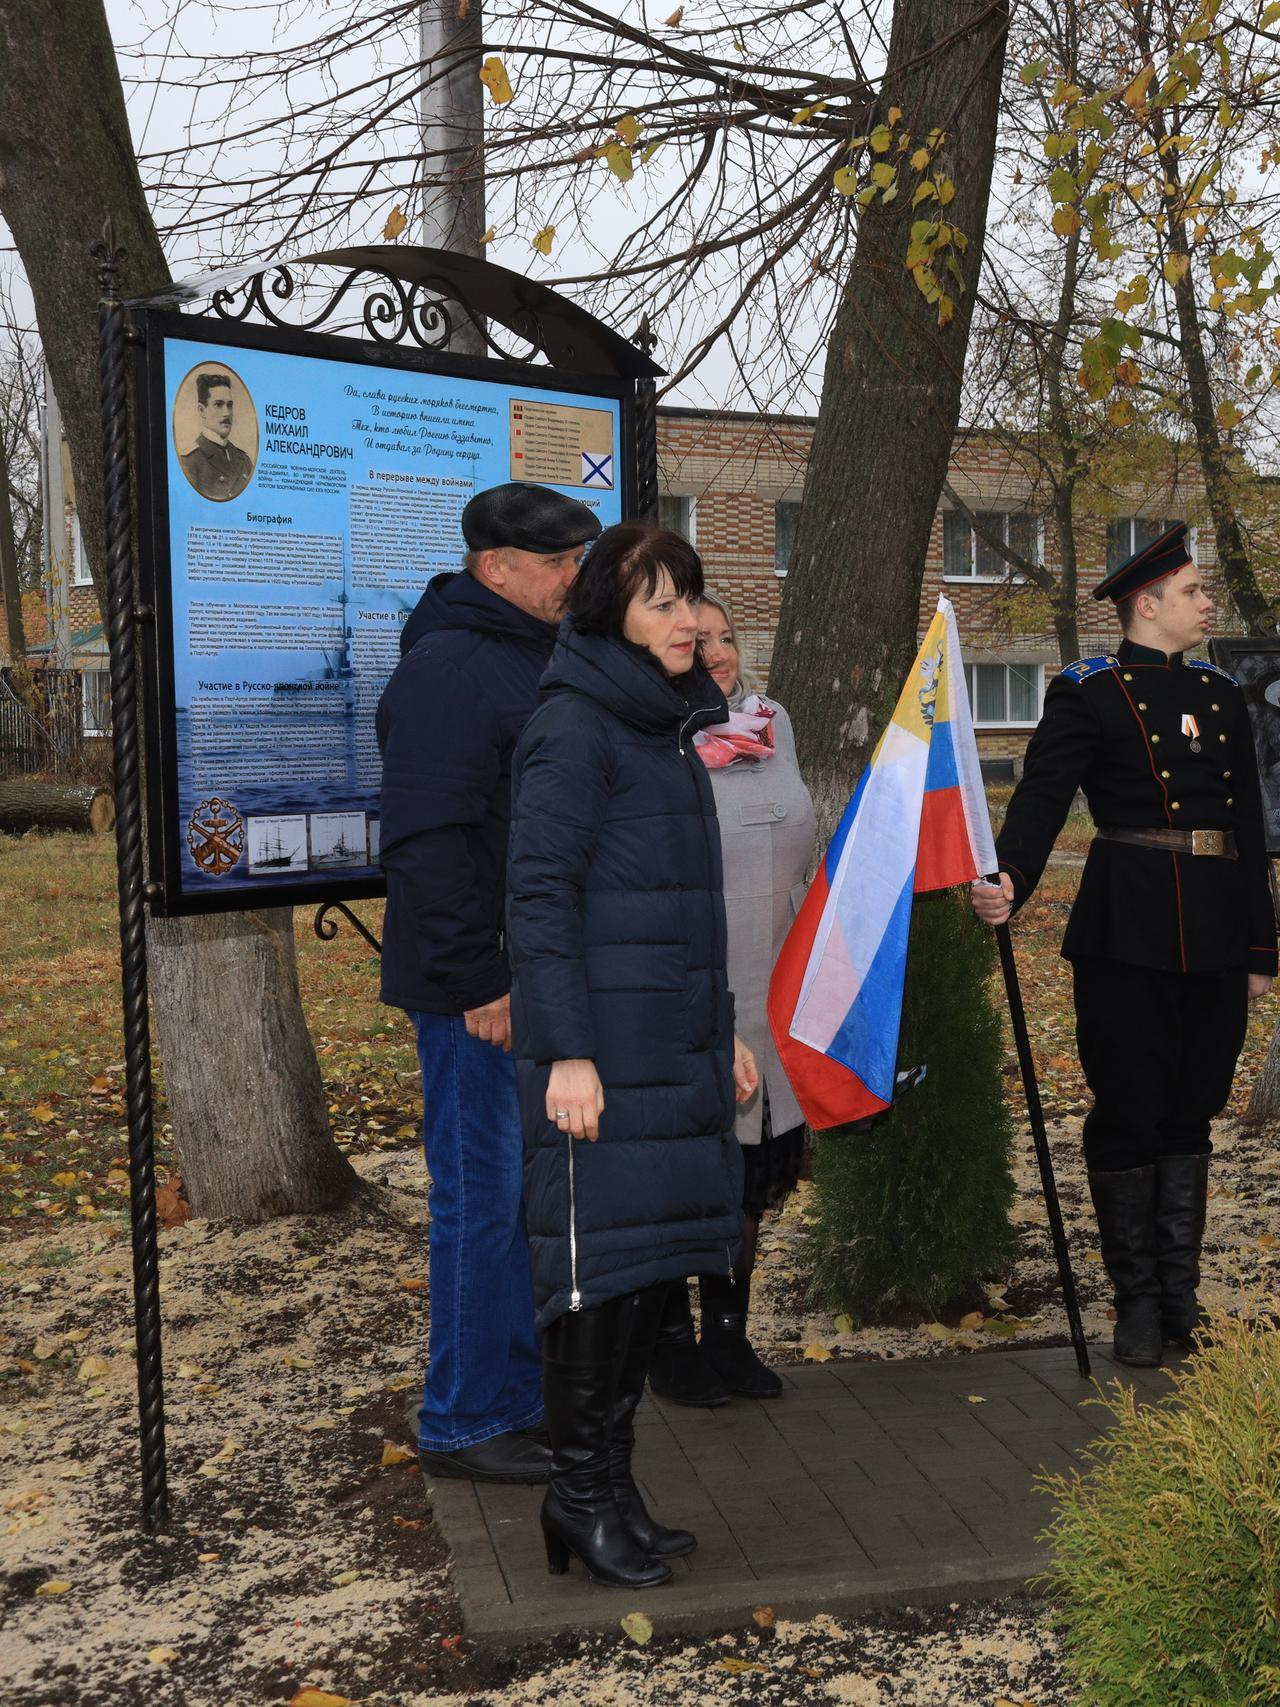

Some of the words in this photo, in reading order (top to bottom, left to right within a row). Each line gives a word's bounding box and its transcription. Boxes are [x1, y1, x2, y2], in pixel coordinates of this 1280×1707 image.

[343, 384, 361, 398] Да,
[362, 389, 387, 400] слава
[387, 392, 418, 404] русских
[420, 398, 453, 409] моряков
[265, 404, 306, 421] КЕДРОВ
[371, 404, 380, 416] В
[381, 411, 417, 422] историю
[419, 411, 450, 425] вписали
[452, 418, 475, 427] имена
[265, 421, 309, 438] МИХАИЛ
[373, 422, 390, 434] кто
[391, 425, 417, 436] любил
[418, 426, 449, 440] Россию
[265, 439, 354, 459] АЛЕКСАНДРОВИЧ
[364, 437, 374, 449] И
[375, 440, 411, 453] отдавал
[410, 446, 421, 456] за
[422, 443, 455, 458] Родину
[369, 470, 374, 480] В
[376, 471, 414, 483] перерыве
[415, 476, 440, 487] между
[441, 477, 473, 488] войнами
[246, 512, 292, 526] Биография
[358, 610, 389, 621] Участие
[391, 613, 396, 621] в
[198, 681, 233, 691] Участие
[235, 683, 240, 691] в
[243, 681, 313, 693] Русско-японской
[315, 682, 340, 691] войне
